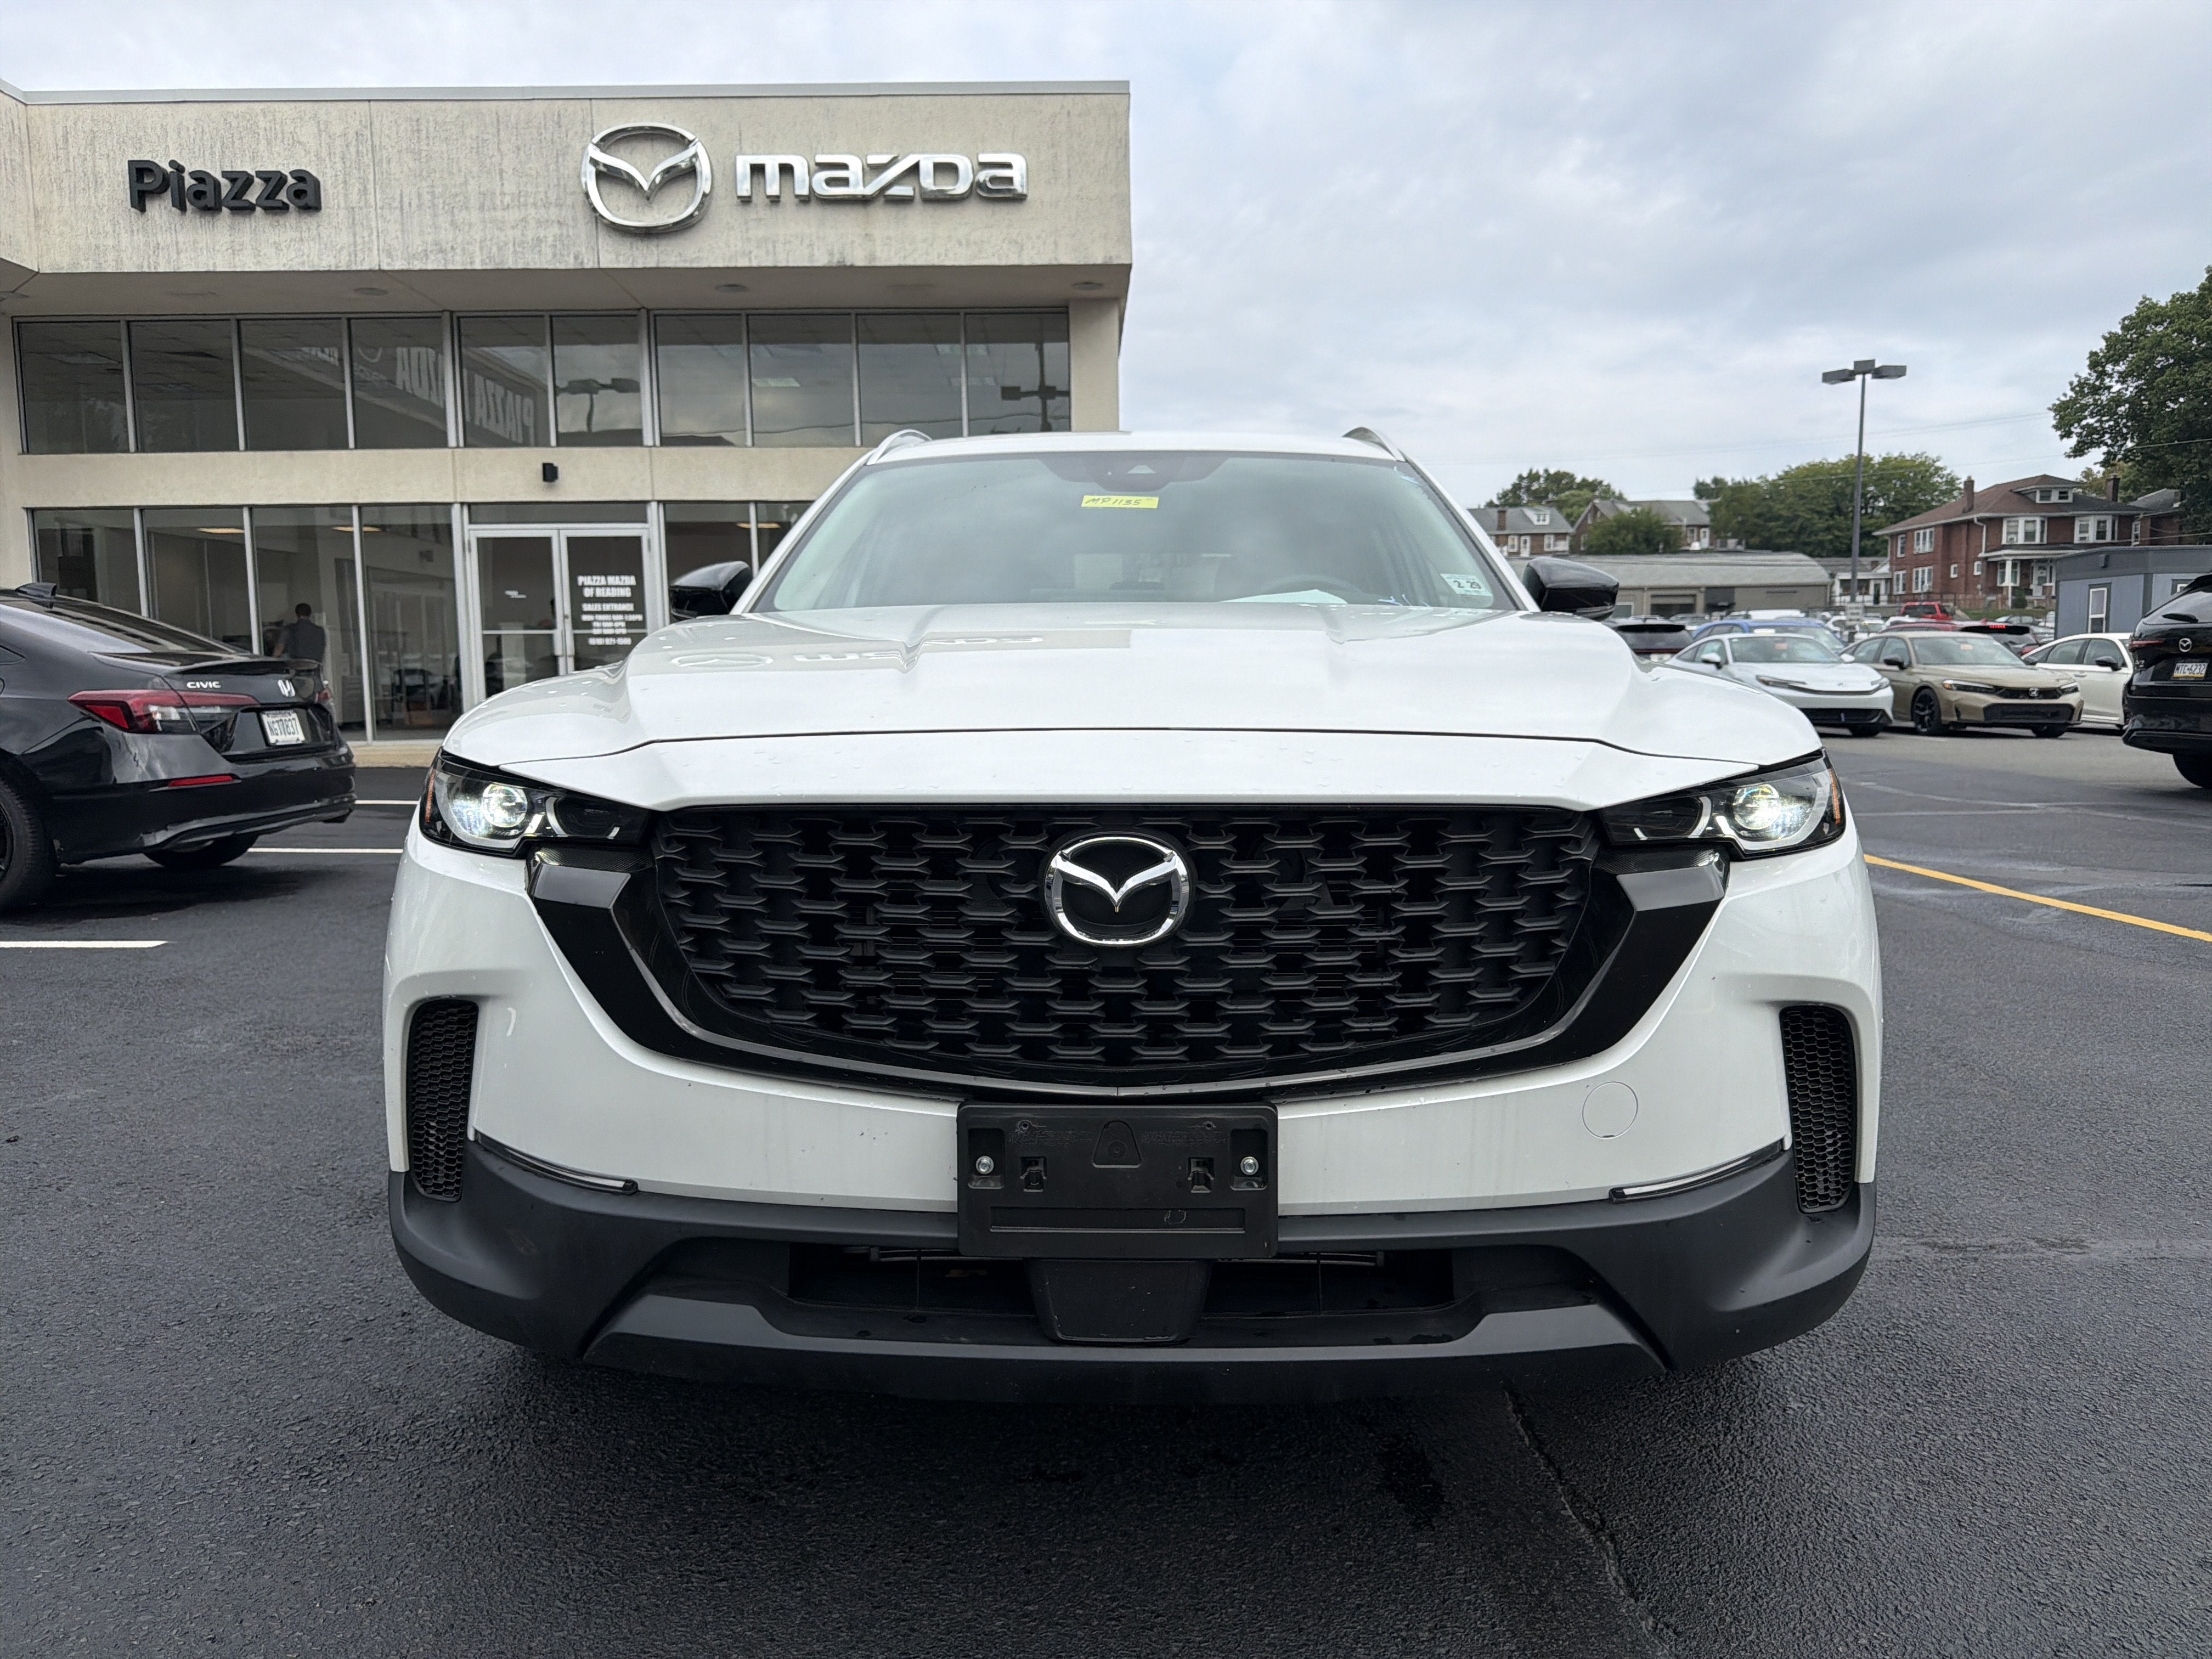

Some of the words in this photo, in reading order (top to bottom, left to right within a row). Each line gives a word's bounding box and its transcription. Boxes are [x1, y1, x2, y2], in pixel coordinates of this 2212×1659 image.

[127, 159, 321, 212] Piazza
[577, 575, 607, 586] PIAZZA
[607, 575, 636, 586] MAZDA
[583, 586, 594, 597] OF
[595, 586, 631, 597] READING
[581, 603, 602, 612] SALES
[187, 681, 221, 689] CIVIC
